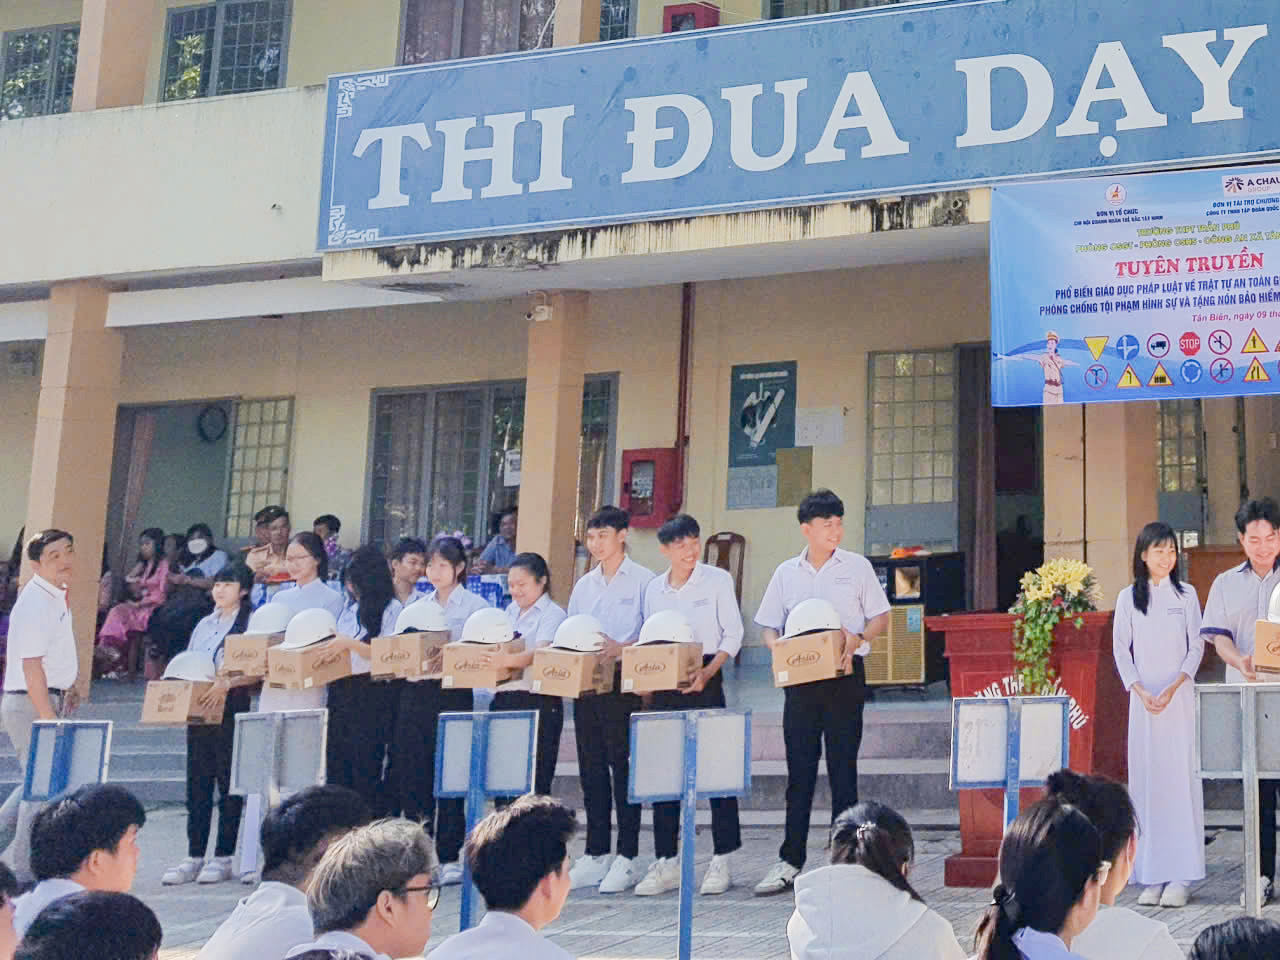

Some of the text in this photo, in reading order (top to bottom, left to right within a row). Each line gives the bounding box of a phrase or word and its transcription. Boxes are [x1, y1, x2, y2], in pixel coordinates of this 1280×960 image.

[353, 104, 575, 210] THI
[621, 71, 910, 185] ĐUA
[954, 23, 1268, 158] DẠY
[1115, 246, 1264, 278] TUYÊN TRUYỀN
[1055, 284, 1072, 300] PHỔ
[1074, 284, 1093, 298] BIẾN
[1095, 283, 1115, 297] GIÁO
[1117, 284, 1134, 298] DỤC
[1136, 281, 1160, 295] PHÁP
[1162, 280, 1183, 294] LUẬT
[1198, 278, 1219, 292] TRẬT
[1221, 278, 1232, 292] TỰ
[1234, 278, 1246, 289] AN
[1248, 275, 1271, 288] TOÀN
[1039, 303, 1068, 316] PHÒNG
[1070, 300, 1098, 314] CHỐNG
[1099, 301, 1113, 315] TỘI
[1115, 299, 1140, 313] PHẠM
[1142, 297, 1163, 310] HÌNH
[1165, 297, 1178, 311] SỰ
[1179, 295, 1191, 308] VÀ
[1192, 294, 1215, 309] TẶNG
[1217, 291, 1237, 305] NÓN
[1238, 290, 1256, 304] BẢO
[1192, 314, 1207, 322] Tân
[1233, 312, 1254, 321] ngày
[1256, 310, 1267, 319] 09
[1180, 338, 1200, 350] STOP
